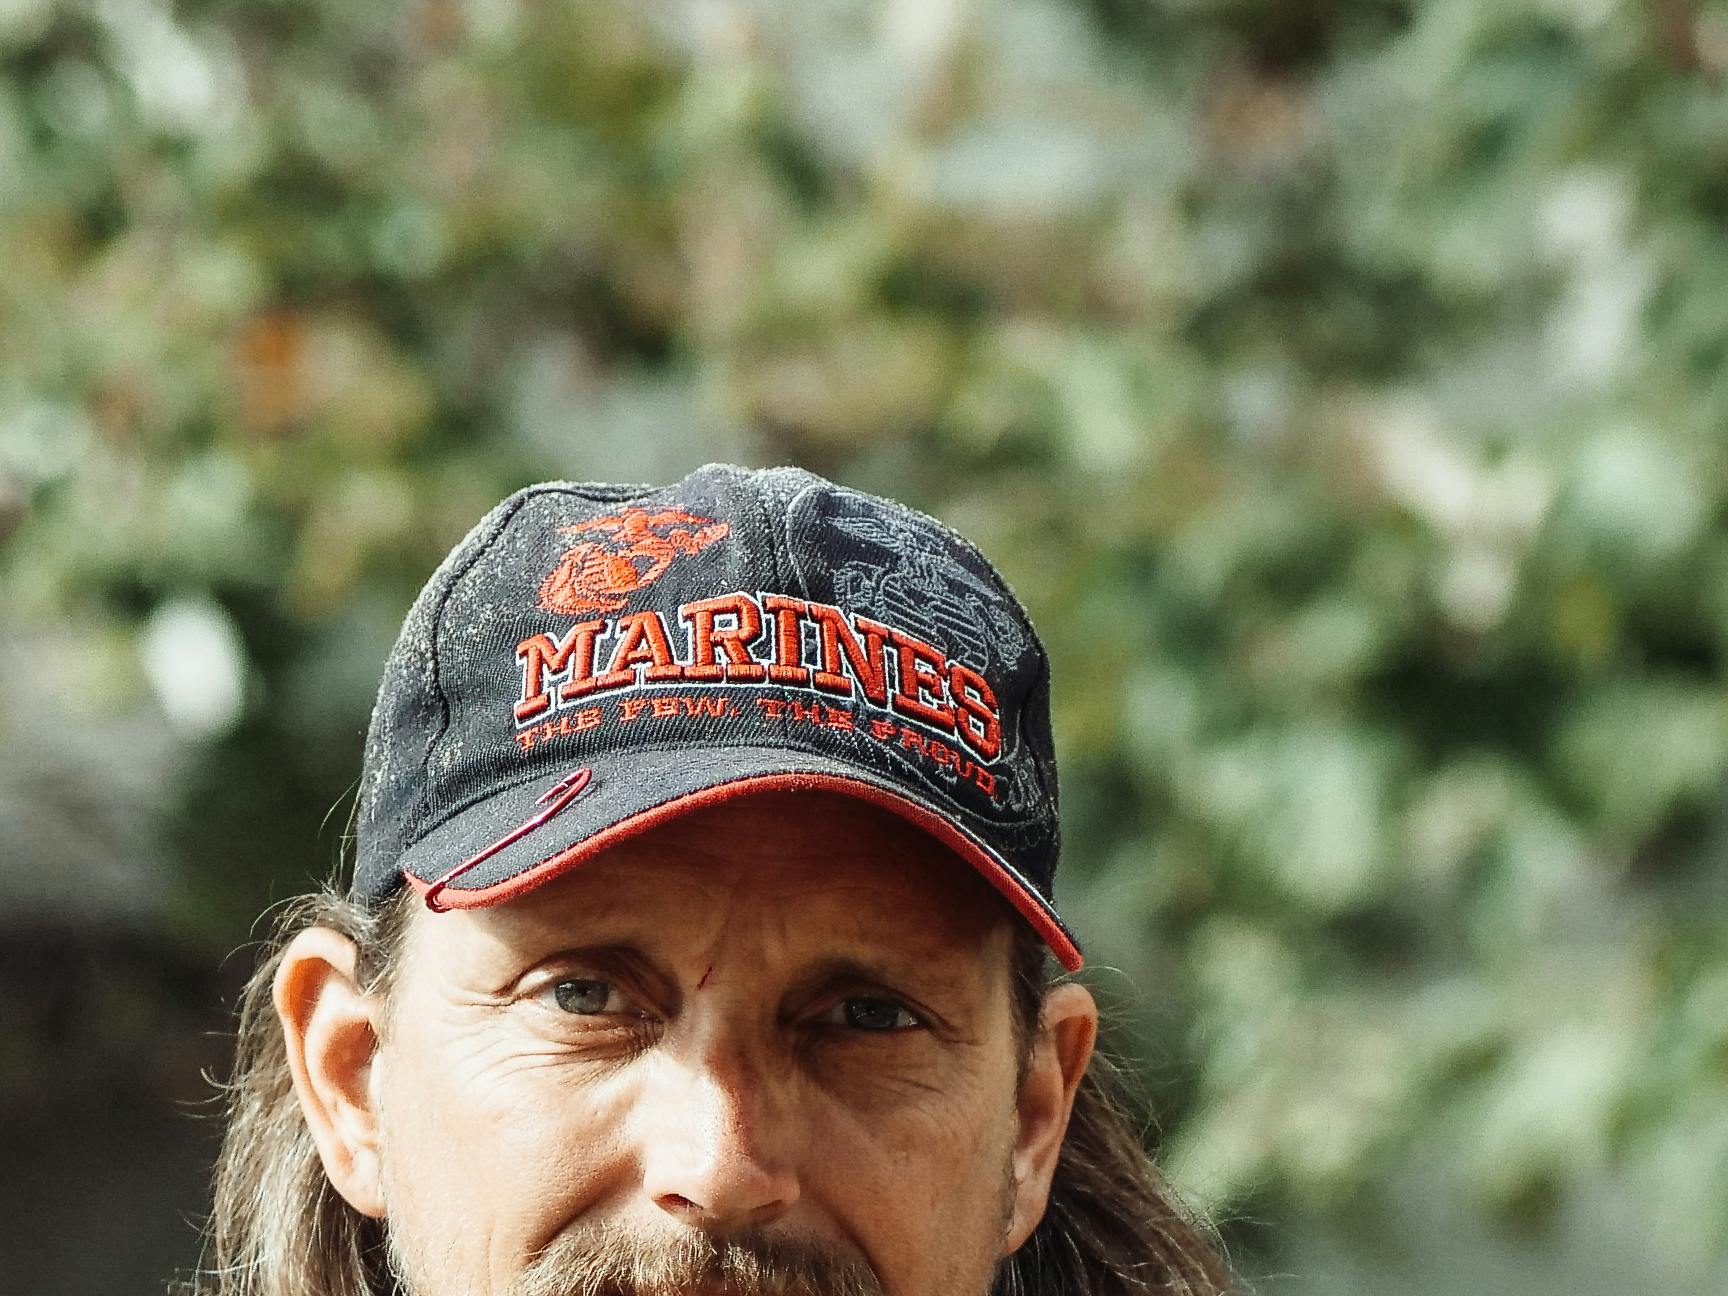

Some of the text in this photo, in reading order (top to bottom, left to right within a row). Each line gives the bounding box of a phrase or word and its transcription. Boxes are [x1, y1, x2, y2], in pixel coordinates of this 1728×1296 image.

[514, 591, 1001, 766] MARINES
[514, 706, 602, 750] THE
[757, 698, 854, 732] THE
[870, 719, 999, 800] PROUD
